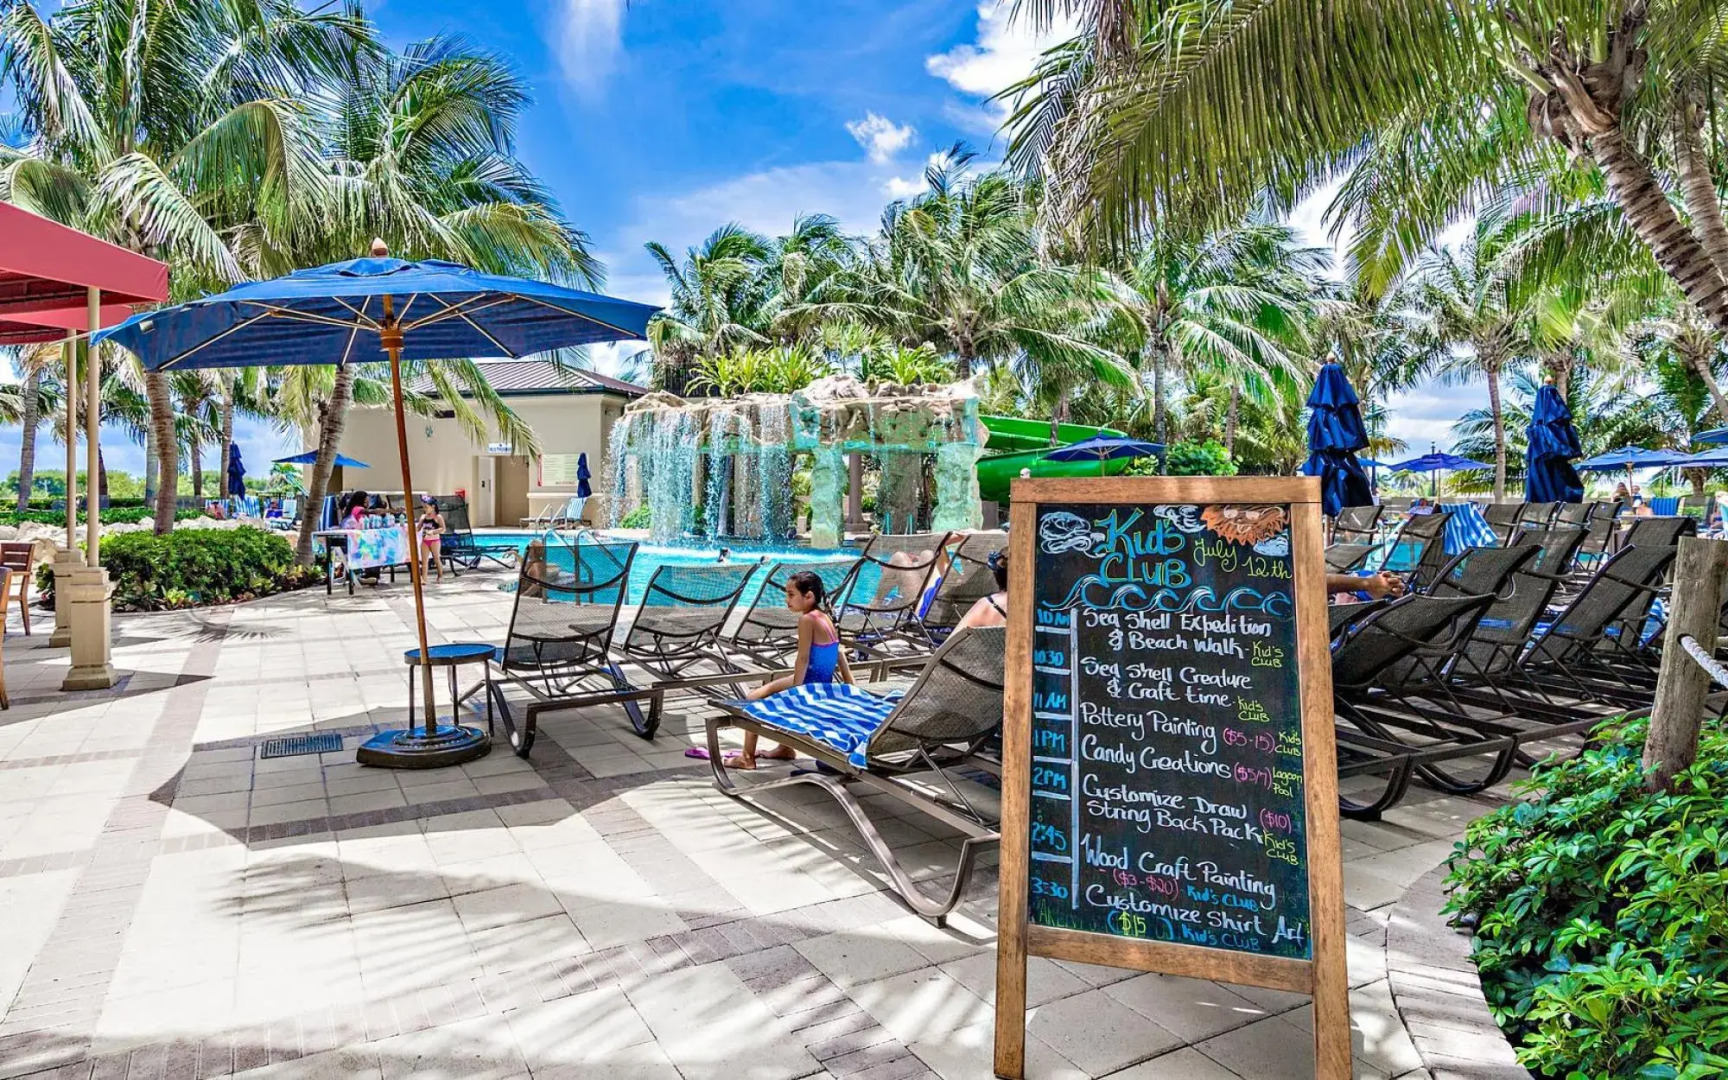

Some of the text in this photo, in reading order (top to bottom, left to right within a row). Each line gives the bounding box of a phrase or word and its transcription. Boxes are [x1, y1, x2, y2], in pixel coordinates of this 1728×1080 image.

[1193, 538, 1293, 580] July 12th
[1082, 607, 1272, 638] Sea Shell Expedition
[1108, 629, 1123, 650] &
[1129, 632, 1188, 650] Beach
[1080, 656, 1253, 690] Sea Shell Creature
[1107, 679, 1122, 699] &
[1128, 682, 1181, 701] Craft
[1080, 701, 1145, 741] Pottery
[1146, 710, 1217, 755] Painting
[1081, 734, 1136, 773] Candy
[1139, 747, 1232, 779] Creations
[1082, 773, 1248, 820] Customize Draw
[1273, 783, 1294, 798] Pool
[1086, 800, 1263, 845] String Back Pack
[1080, 833, 1276, 910] Wood Craft Painting
[1086, 884, 1202, 923] Customize
[1207, 910, 1267, 936] Shirt
[1271, 915, 1304, 949] Art
